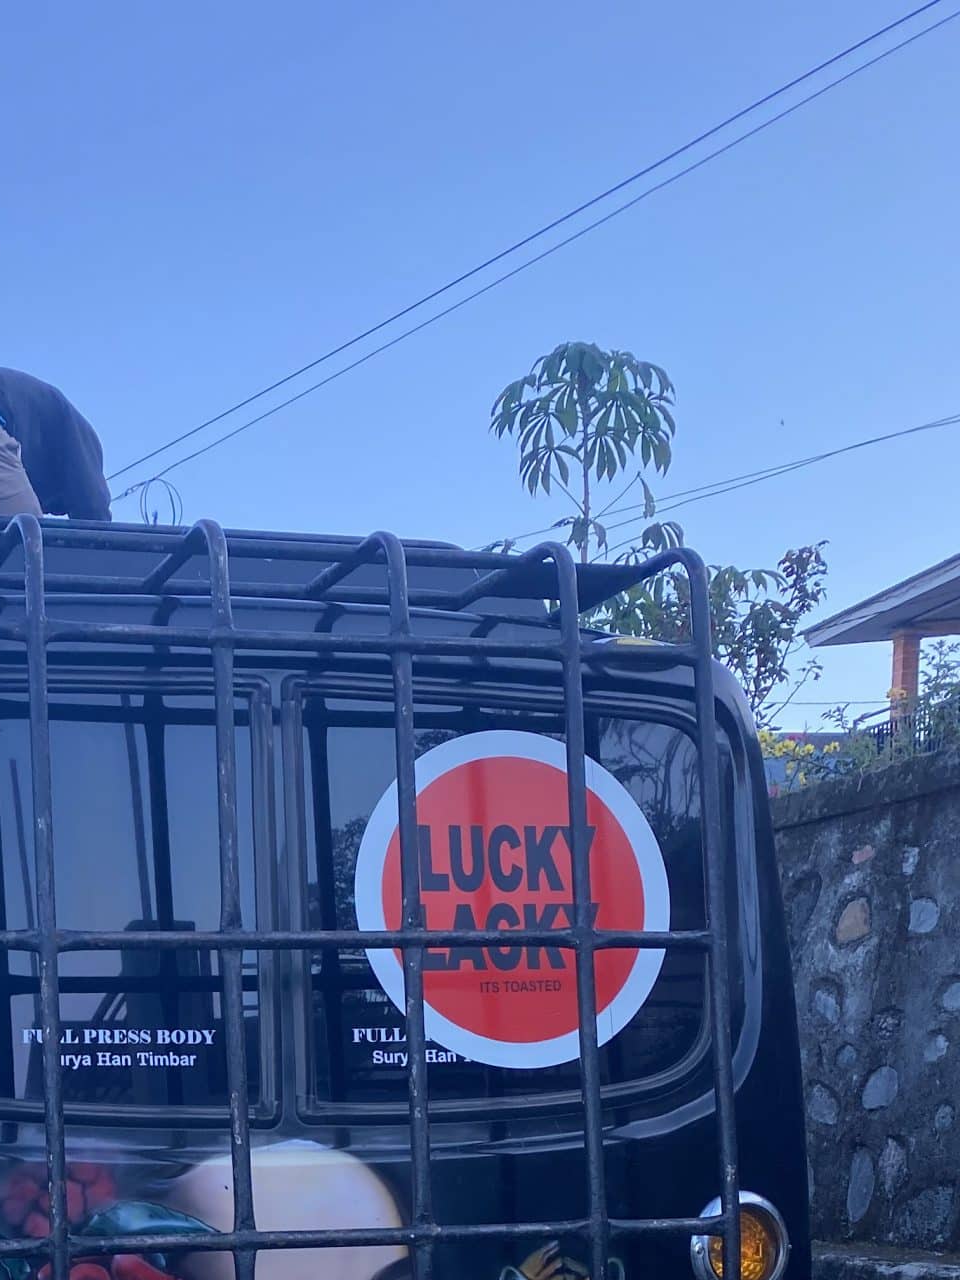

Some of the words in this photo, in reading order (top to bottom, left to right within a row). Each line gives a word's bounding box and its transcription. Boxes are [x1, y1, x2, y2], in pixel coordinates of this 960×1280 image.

[480, 981, 500, 993] ITS
[503, 980, 562, 993] TOASTED
[23, 1029, 79, 1044] FUL
[83, 1029, 152, 1044] PRESS
[156, 1029, 217, 1044] BODY
[352, 1028, 407, 1042] FULL
[97, 1052, 132, 1066] Han
[137, 1052, 197, 1067] Timbar
[372, 1050, 408, 1066] Sury
[425, 1050, 457, 1063] Han
